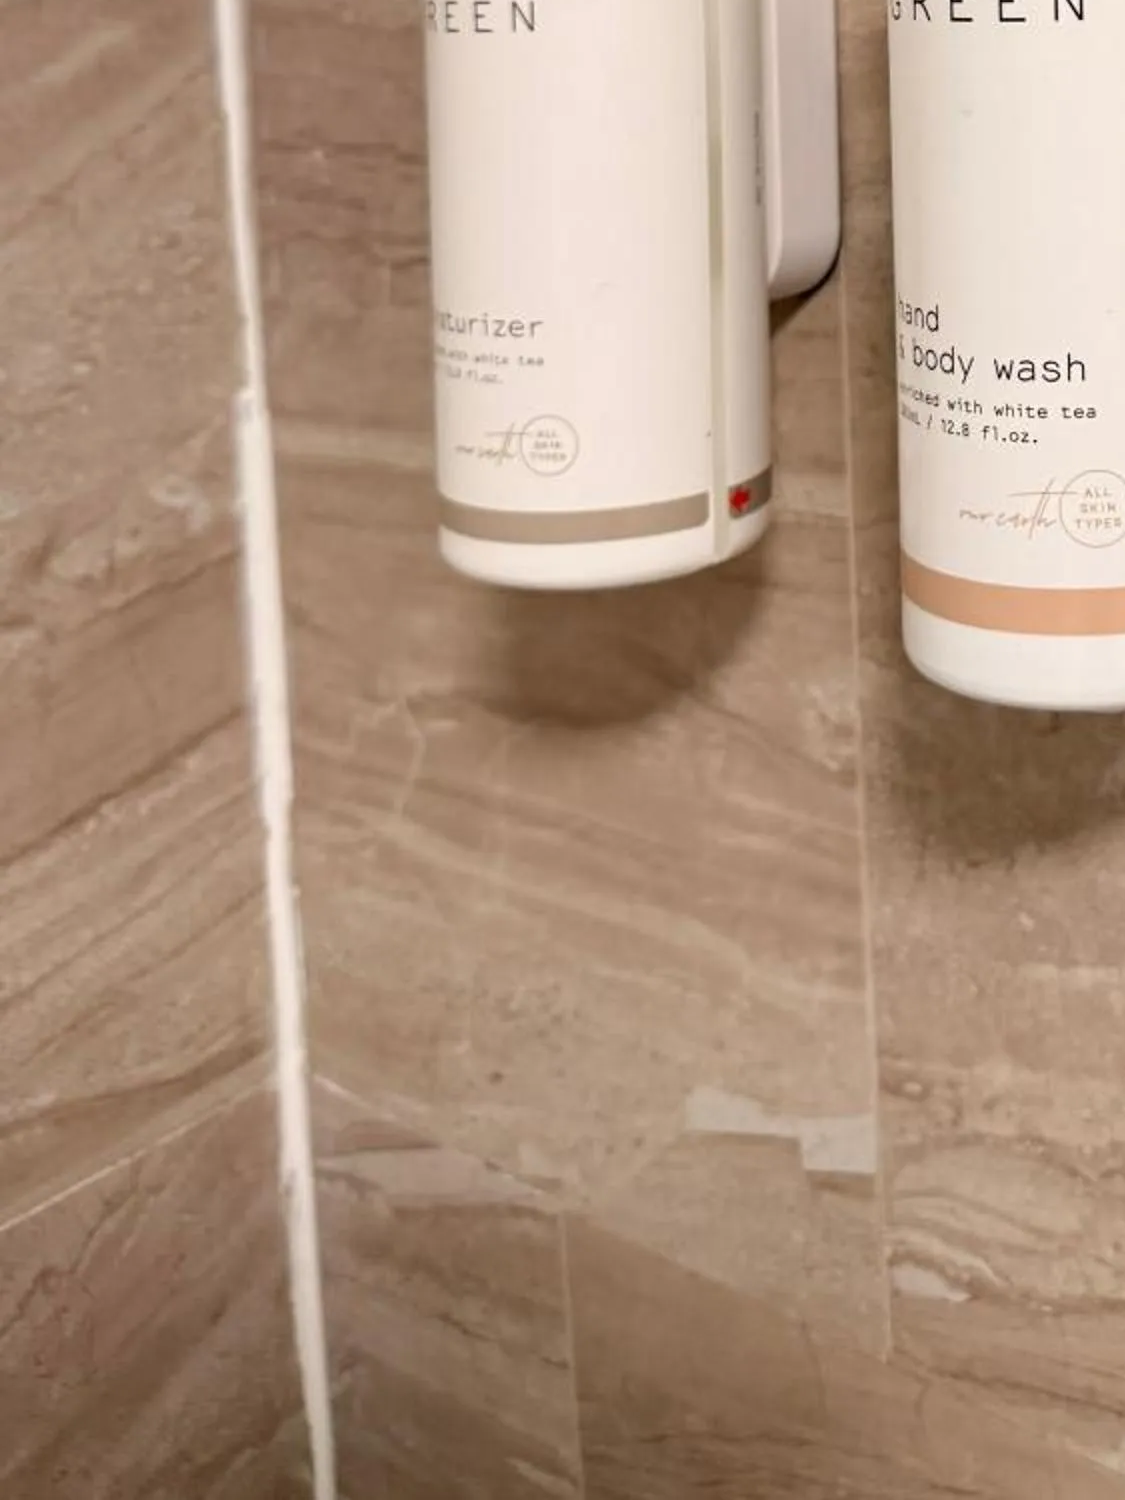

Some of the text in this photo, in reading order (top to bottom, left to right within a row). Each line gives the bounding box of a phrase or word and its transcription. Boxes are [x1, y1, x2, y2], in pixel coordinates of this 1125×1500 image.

[426, 0, 535, 33] REEN
[911, 338, 975, 384] body
[993, 352, 1087, 383] wash
[947, 397, 984, 416] with
[994, 403, 1049, 420] white
[1060, 405, 1098, 420] tea
[1084, 487, 1113, 499] ALL
[1080, 502, 1118, 514] SKIN
[1075, 517, 1123, 529] TYPES
